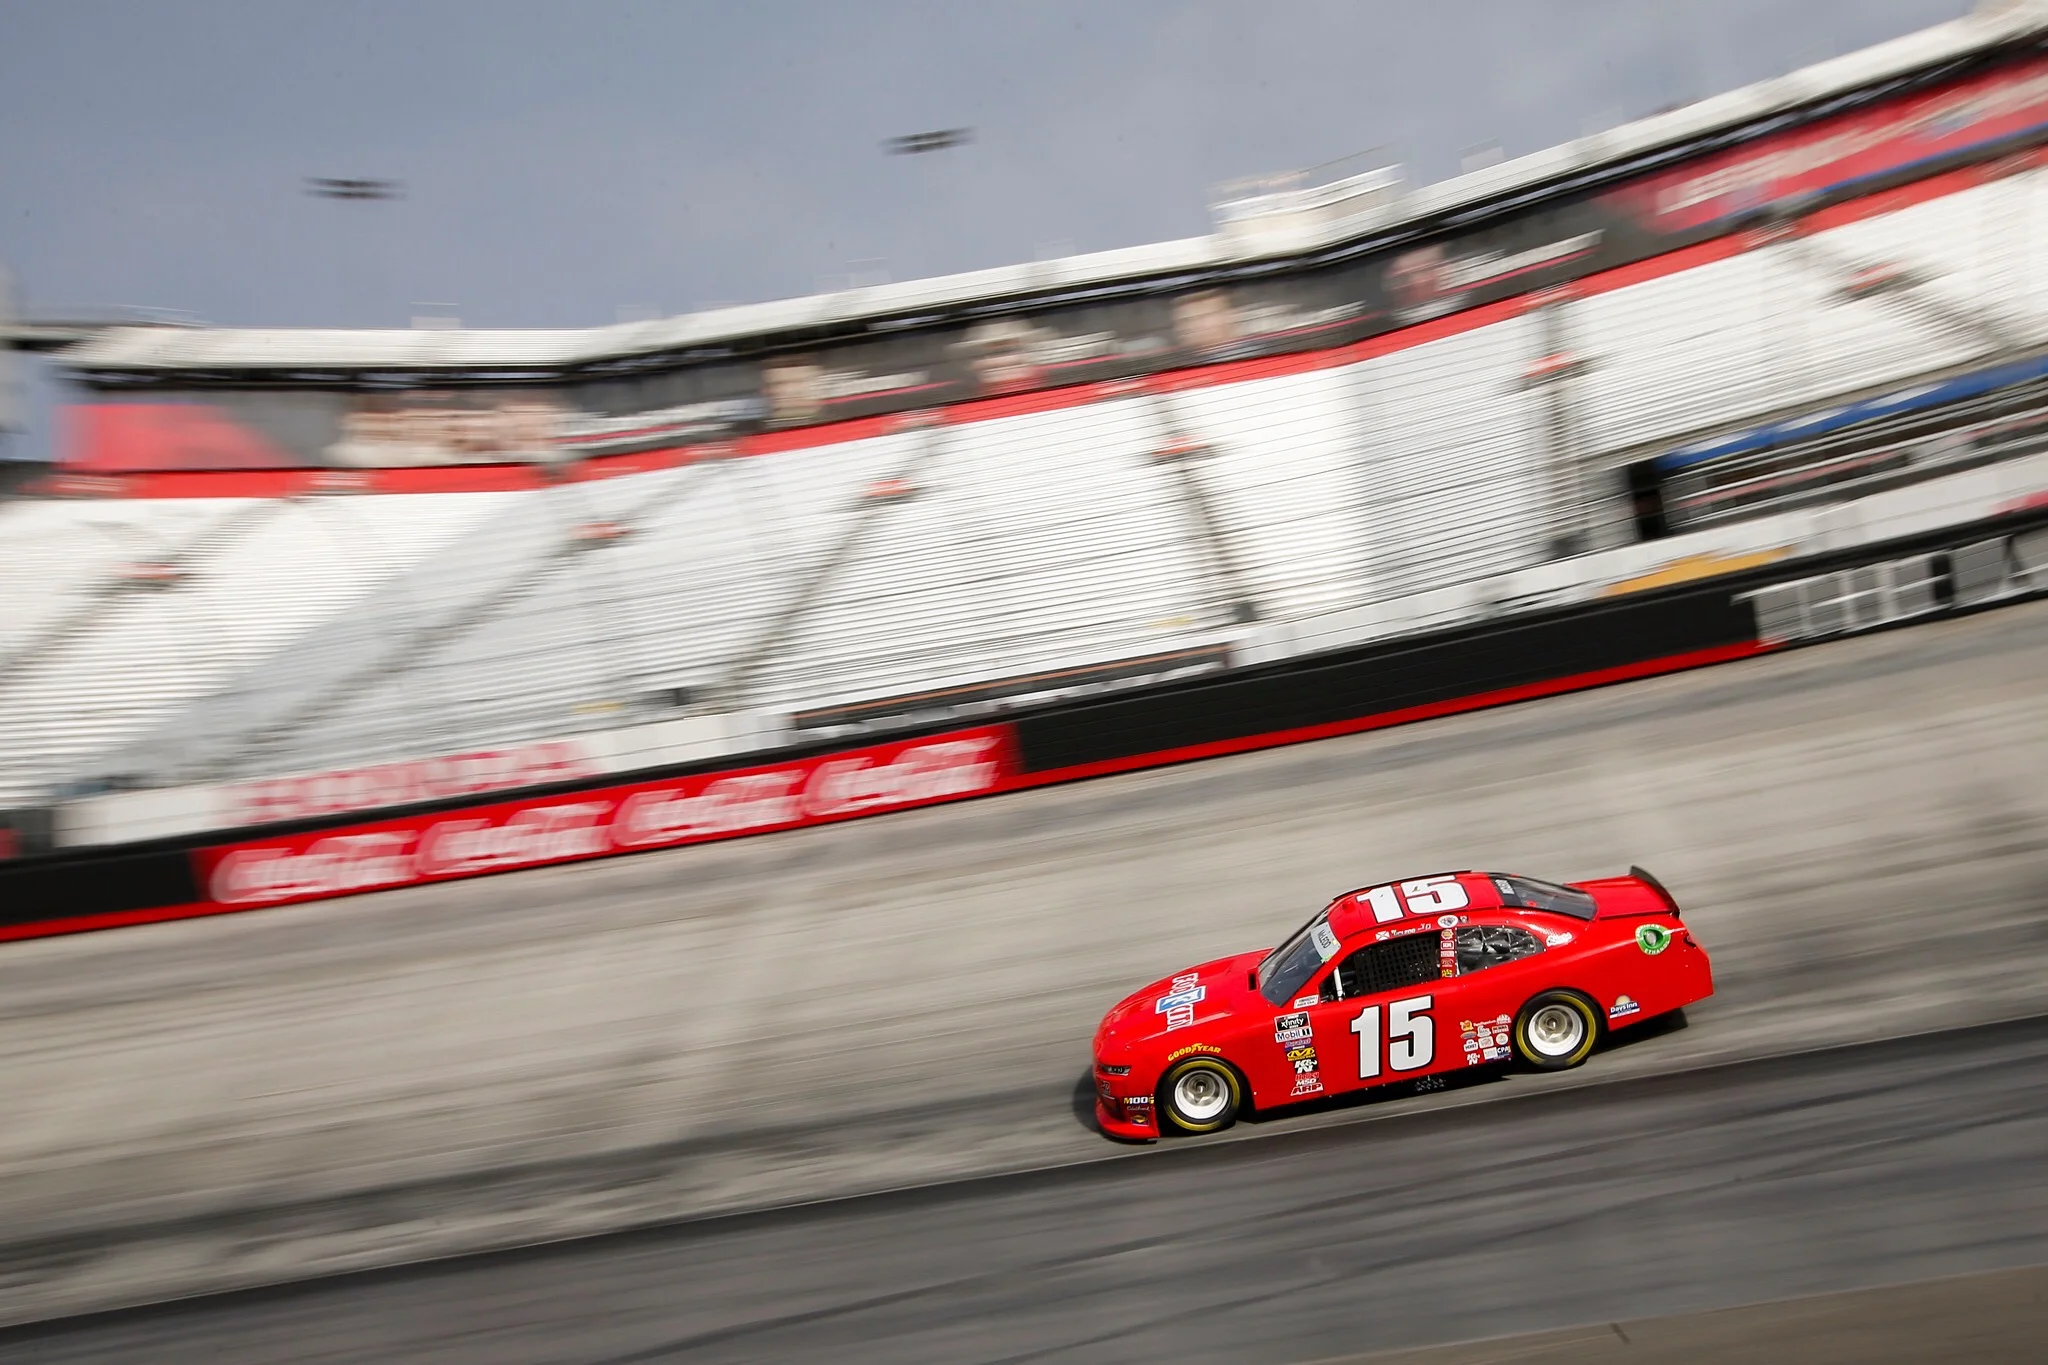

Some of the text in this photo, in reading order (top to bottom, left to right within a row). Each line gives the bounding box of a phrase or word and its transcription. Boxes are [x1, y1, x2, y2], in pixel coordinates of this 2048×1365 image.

[1356, 875, 1469, 923] 15
[1281, 1018, 1304, 1029] xfinity
[1277, 1028, 1311, 1041] Mobil 1
[1350, 995, 1434, 1079] 15
[1168, 1043, 1222, 1061] GOODYEAR
[1293, 1084, 1321, 1094] ARP
[1296, 1079, 1317, 1087] MSD
